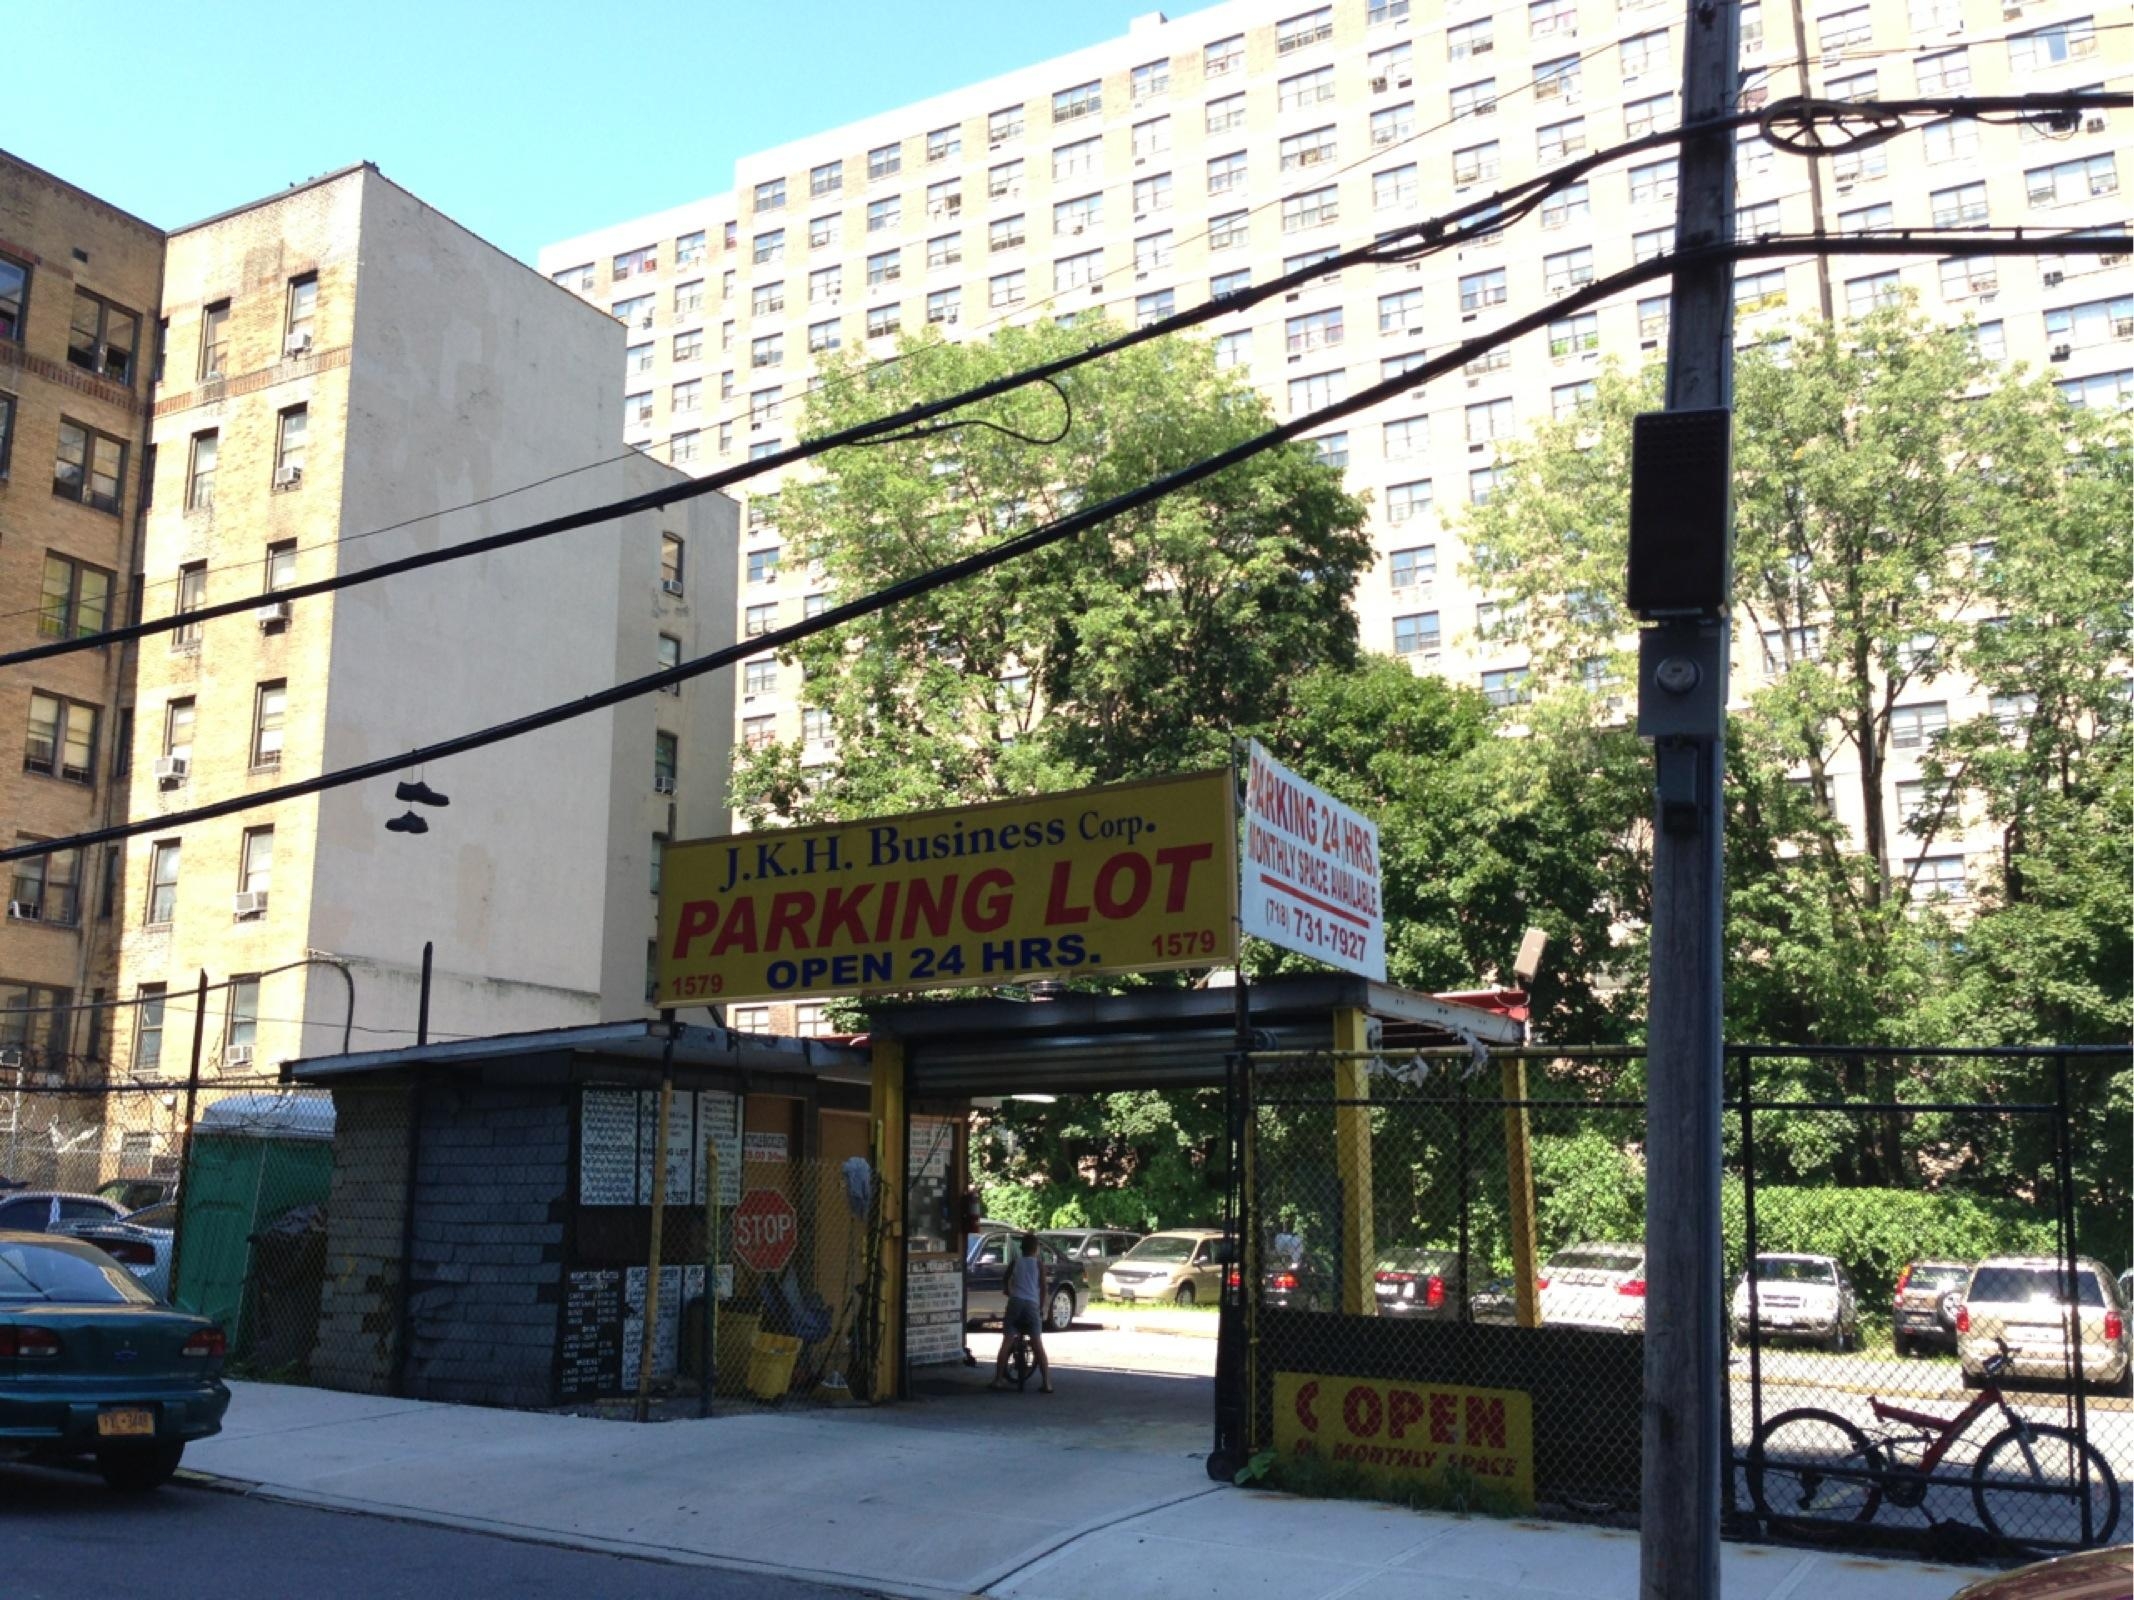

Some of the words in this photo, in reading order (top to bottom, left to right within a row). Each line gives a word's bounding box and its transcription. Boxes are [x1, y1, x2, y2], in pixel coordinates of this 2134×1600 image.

[1247, 756, 1317, 847] PARKING
[1321, 805, 1340, 859] 24
[1342, 817, 1377, 879] HRS.
[718, 835, 853, 893] J.K.H.
[867, 817, 1066, 868] Business
[1078, 810, 1156, 845] Corp.
[1247, 822, 1296, 882] MONTHLY
[1297, 848, 1329, 896] SPACE
[1331, 866, 1378, 919] AVAILABLE
[672, 867, 1016, 960] PARKING
[1043, 842, 1214, 926] LOT
[1266, 897, 1290, 935] (718)
[1293, 907, 1367, 963] 731-7927
[766, 951, 893, 990] OPEN
[909, 944, 965, 980] 24
[982, 933, 1102, 973] HRS.
[1151, 929, 1216, 958] 1579
[672, 973, 723, 996] 1579
[738, 1215, 791, 1246] STOP
[1343, 1385, 1506, 1449] OPEN
[1333, 1441, 1437, 1469] MONTHLY
